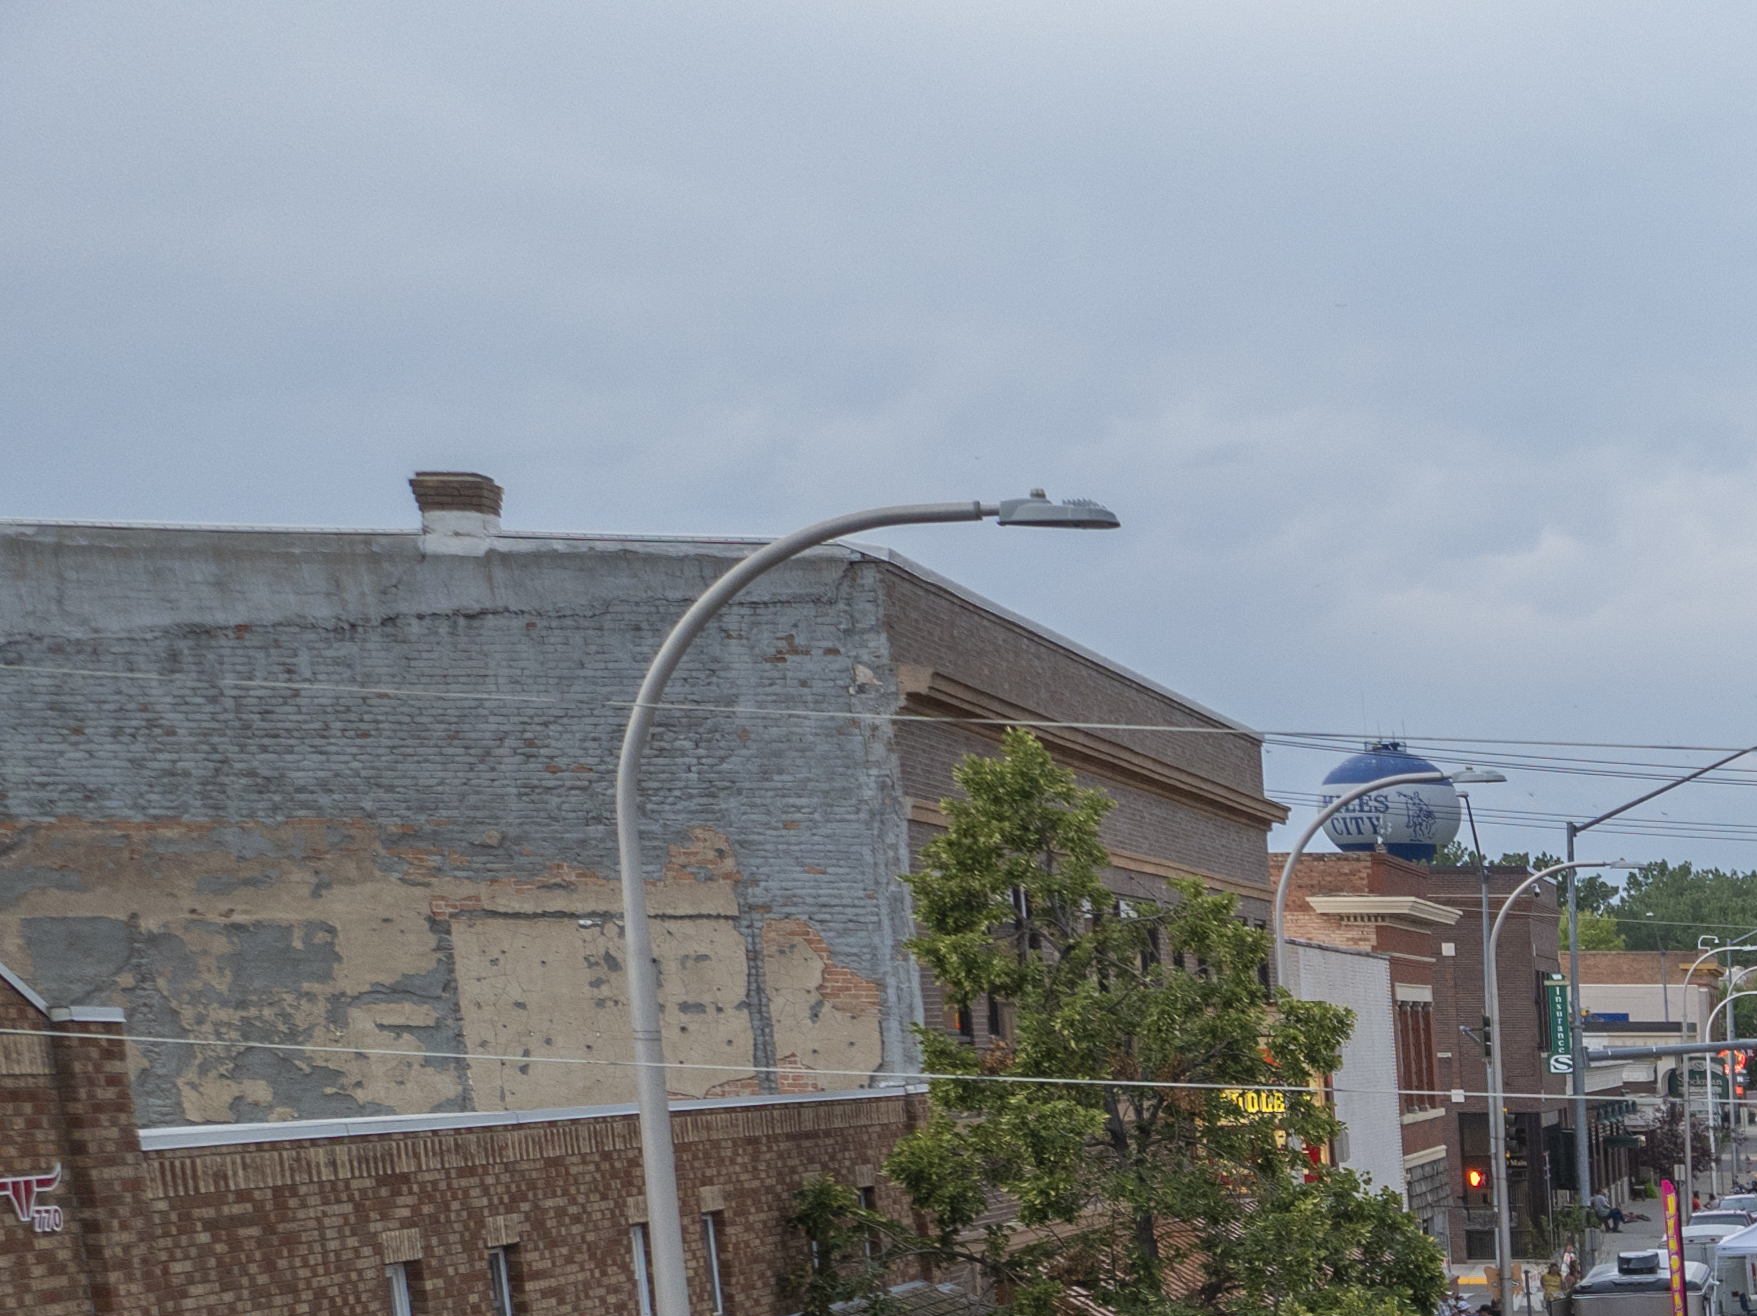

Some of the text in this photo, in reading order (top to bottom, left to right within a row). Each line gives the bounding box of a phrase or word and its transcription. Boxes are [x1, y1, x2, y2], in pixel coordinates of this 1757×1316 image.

[1330, 816, 1381, 836] CITY
[1555, 986, 1566, 1054] Insurance
[34, 1206, 63, 1232] 770
